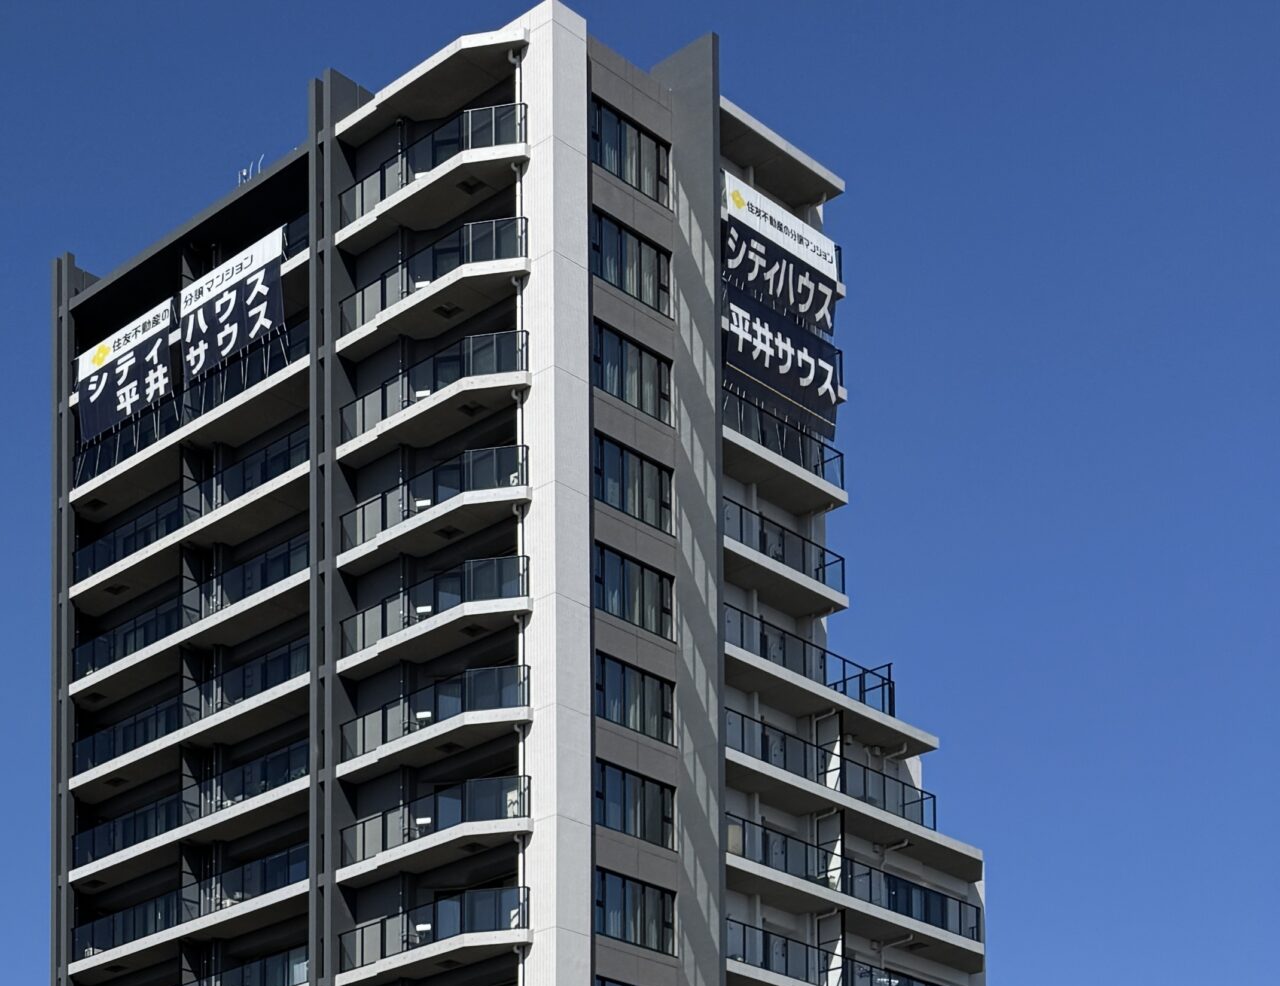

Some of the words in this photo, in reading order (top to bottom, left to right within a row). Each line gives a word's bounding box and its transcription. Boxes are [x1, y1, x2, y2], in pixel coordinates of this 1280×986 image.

[184, 268, 271, 344] ハウス
[727, 226, 833, 329] シティハウス
[116, 363, 169, 416] 平井
[185, 301, 273, 375] サウス
[729, 302, 837, 405] 平井サウス
